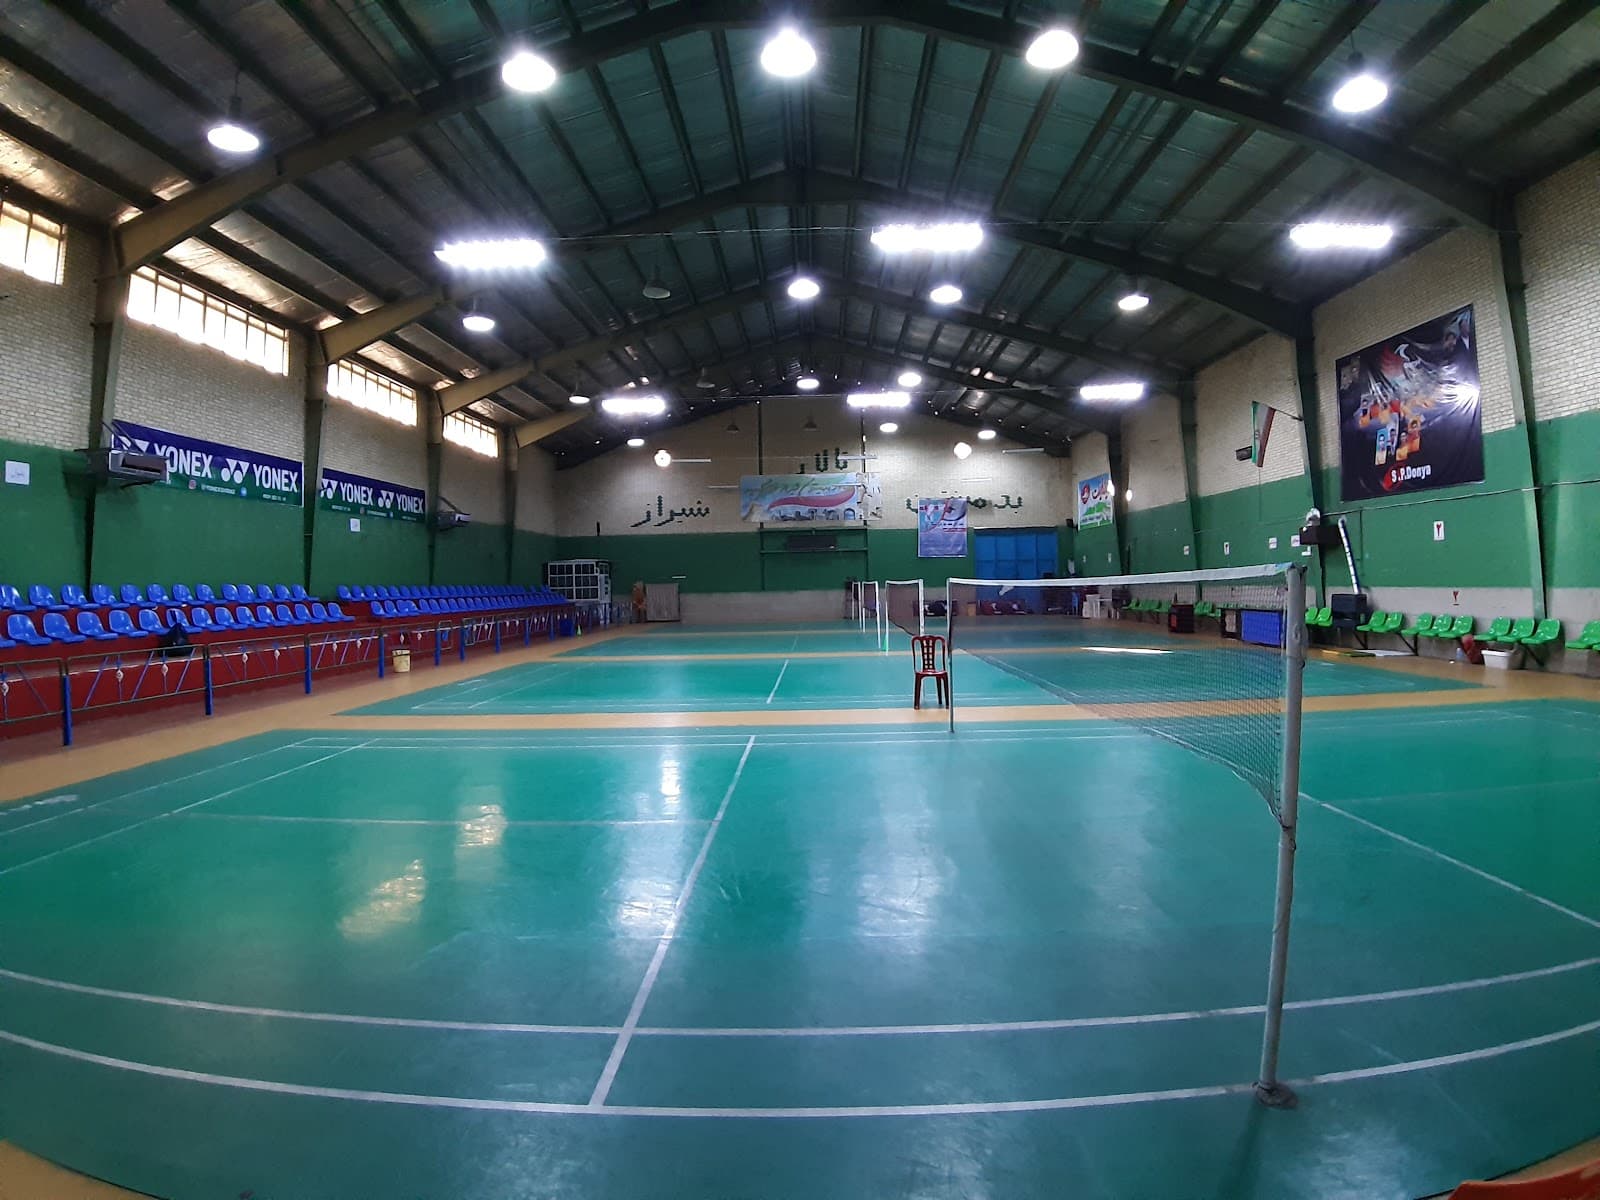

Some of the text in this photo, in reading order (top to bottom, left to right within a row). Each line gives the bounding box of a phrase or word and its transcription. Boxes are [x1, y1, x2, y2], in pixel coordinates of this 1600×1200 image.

[154, 443, 298, 493] YONEX YONEX
[339, 481, 424, 514] YONEX YONEX
[629, 495, 710, 528] شیراز
